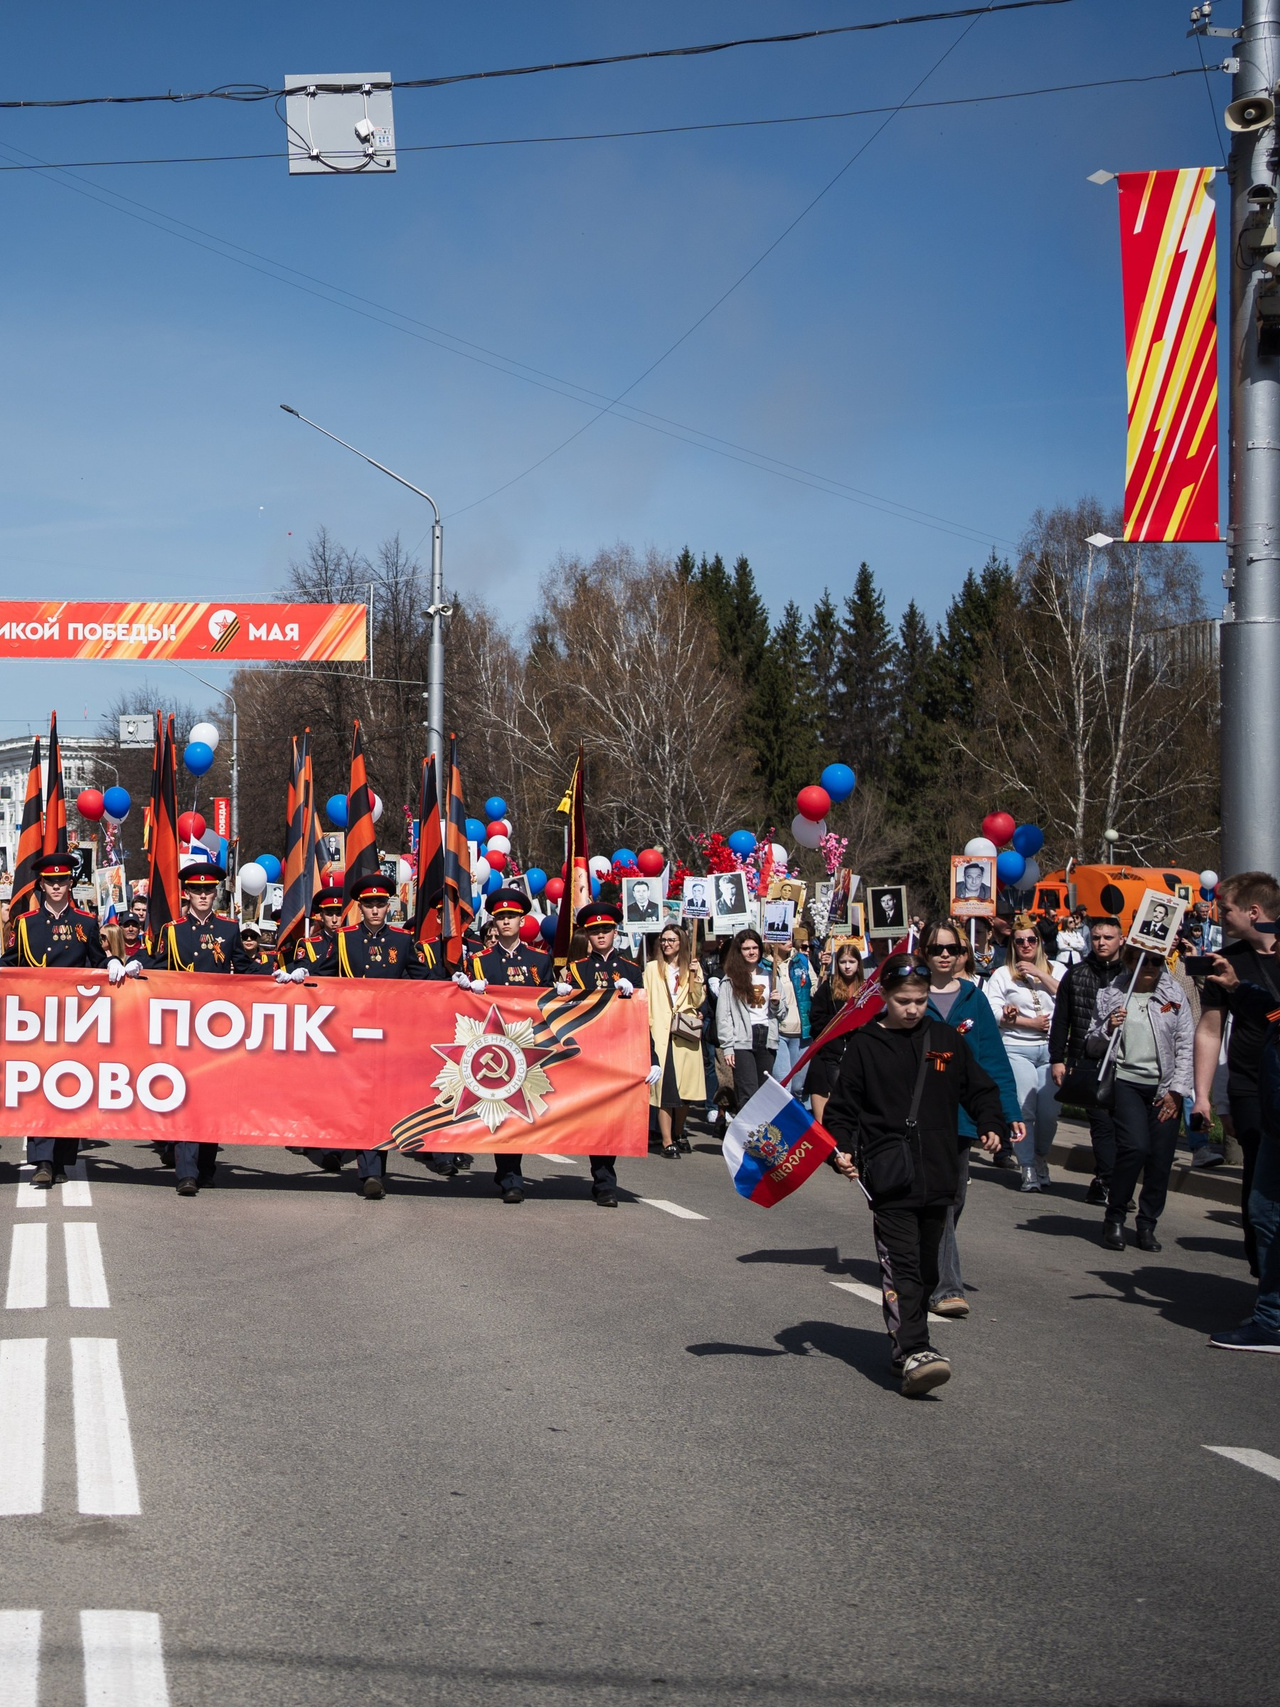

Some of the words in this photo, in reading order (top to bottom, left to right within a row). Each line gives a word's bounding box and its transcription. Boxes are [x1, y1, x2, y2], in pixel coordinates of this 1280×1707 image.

[67, 622, 177, 645] ПОБЕДЫ!
[248, 622, 299, 641] МАЯ
[218, 800, 227, 835] ПОБЕДА!
[148, 997, 338, 1053] ПОЛК
